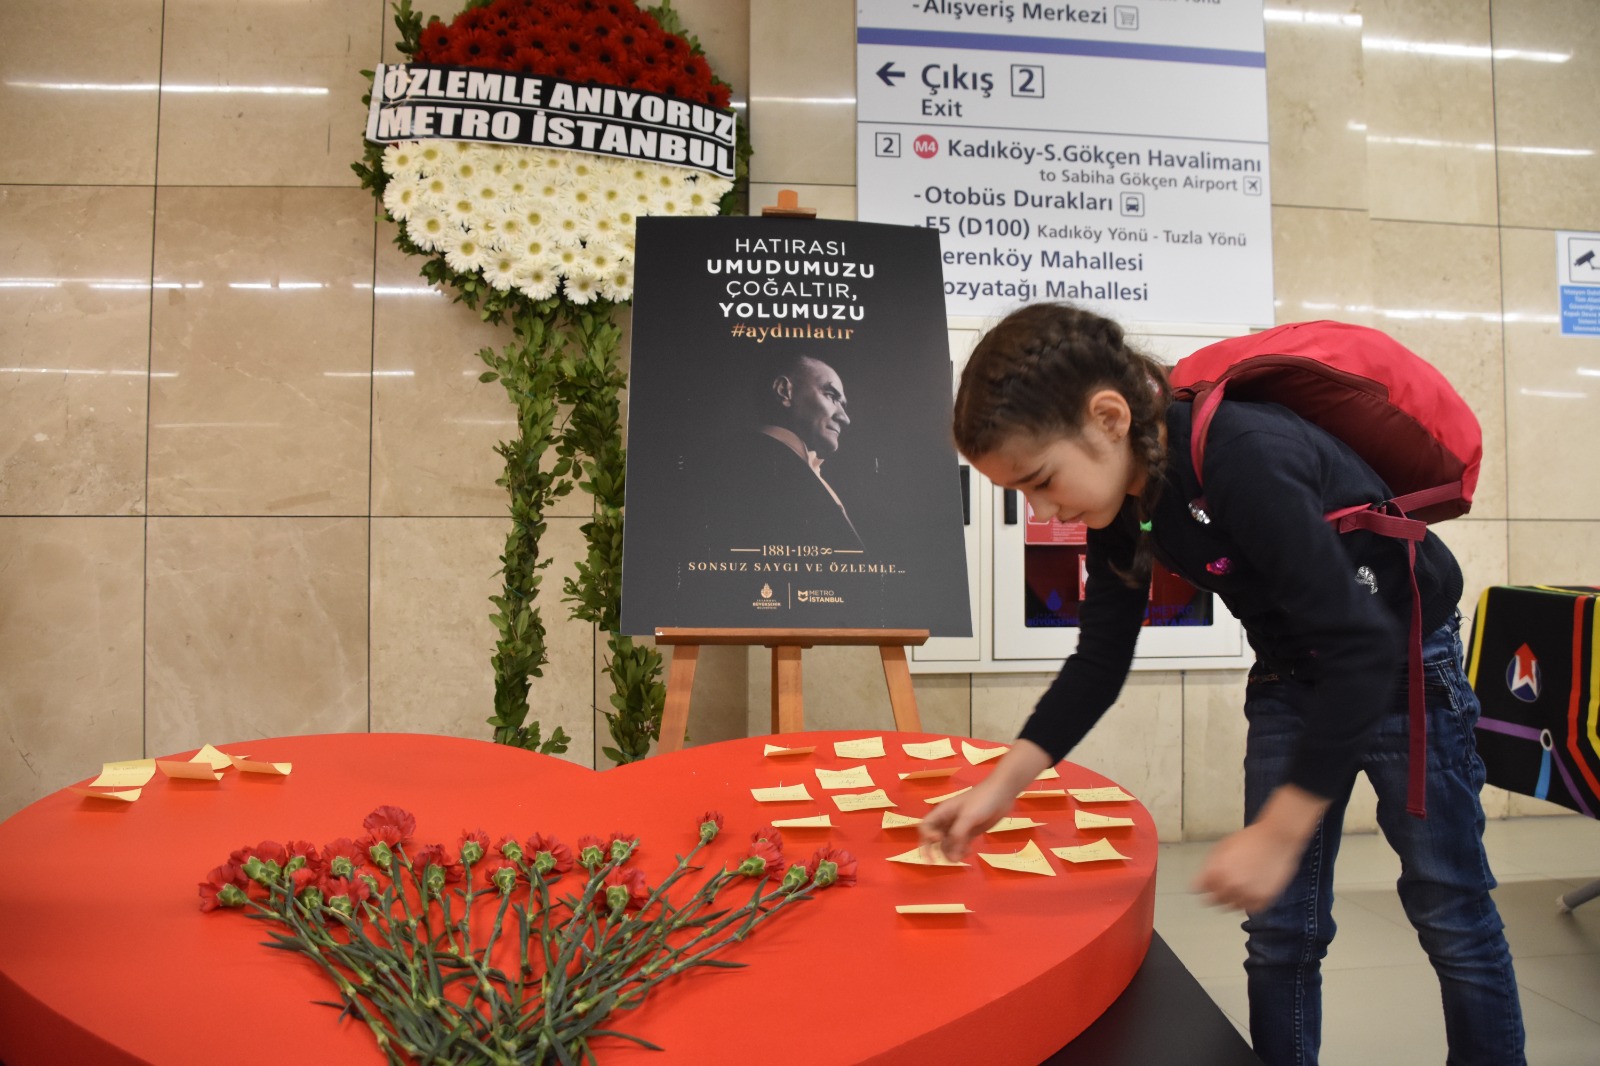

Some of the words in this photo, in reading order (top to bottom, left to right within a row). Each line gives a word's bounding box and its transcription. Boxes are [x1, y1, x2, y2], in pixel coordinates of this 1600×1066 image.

[1022, 4, 1107, 25] Merkezi
[921, 64, 994, 97] Çıkış
[1018, 69, 1035, 93] 2
[383, 64, 545, 107] ÖZLEMLE
[549, 82, 734, 141] ANIYORUZ
[921, 99, 963, 118] Exit
[378, 106, 520, 140] METRO
[531, 111, 734, 176] İSTANBUL
[882, 138, 894, 153] 2
[915, 139, 936, 153] M4
[948, 139, 1140, 171] Kadıköy-S.Gökçen
[1148, 150, 1261, 172] Havalimanı
[1040, 170, 1055, 182] to
[1062, 171, 1114, 185] Sabiha
[1120, 173, 1177, 191] Gökçen
[1183, 176, 1238, 194] Airport
[1014, 189, 1113, 212] Durakları
[959, 216, 1030, 240] (D100)
[1037, 226, 1102, 244] Kadıköy
[1108, 228, 1148, 243] Yönü
[1163, 230, 1202, 245] Tuzla
[1208, 232, 1247, 247] Yönü
[735, 238, 846, 256] HATIRASI
[706, 259, 875, 279] UMUDUMUZU
[942, 247, 1032, 272] erenköy
[1041, 250, 1143, 272] Mahallesi
[726, 278, 857, 301] ÇOĞALTIR,
[944, 279, 1036, 302] ozyatağı
[1046, 279, 1148, 301] Mahallesi
[719, 303, 865, 321] YOLUMUZU
[731, 323, 854, 343] #aydınlatır
[688, 562, 748, 571] SONSUZ
[754, 562, 799, 572] SAYGI
[805, 563, 823, 572] VE
[809, 595, 844, 603] İSTANBUL
